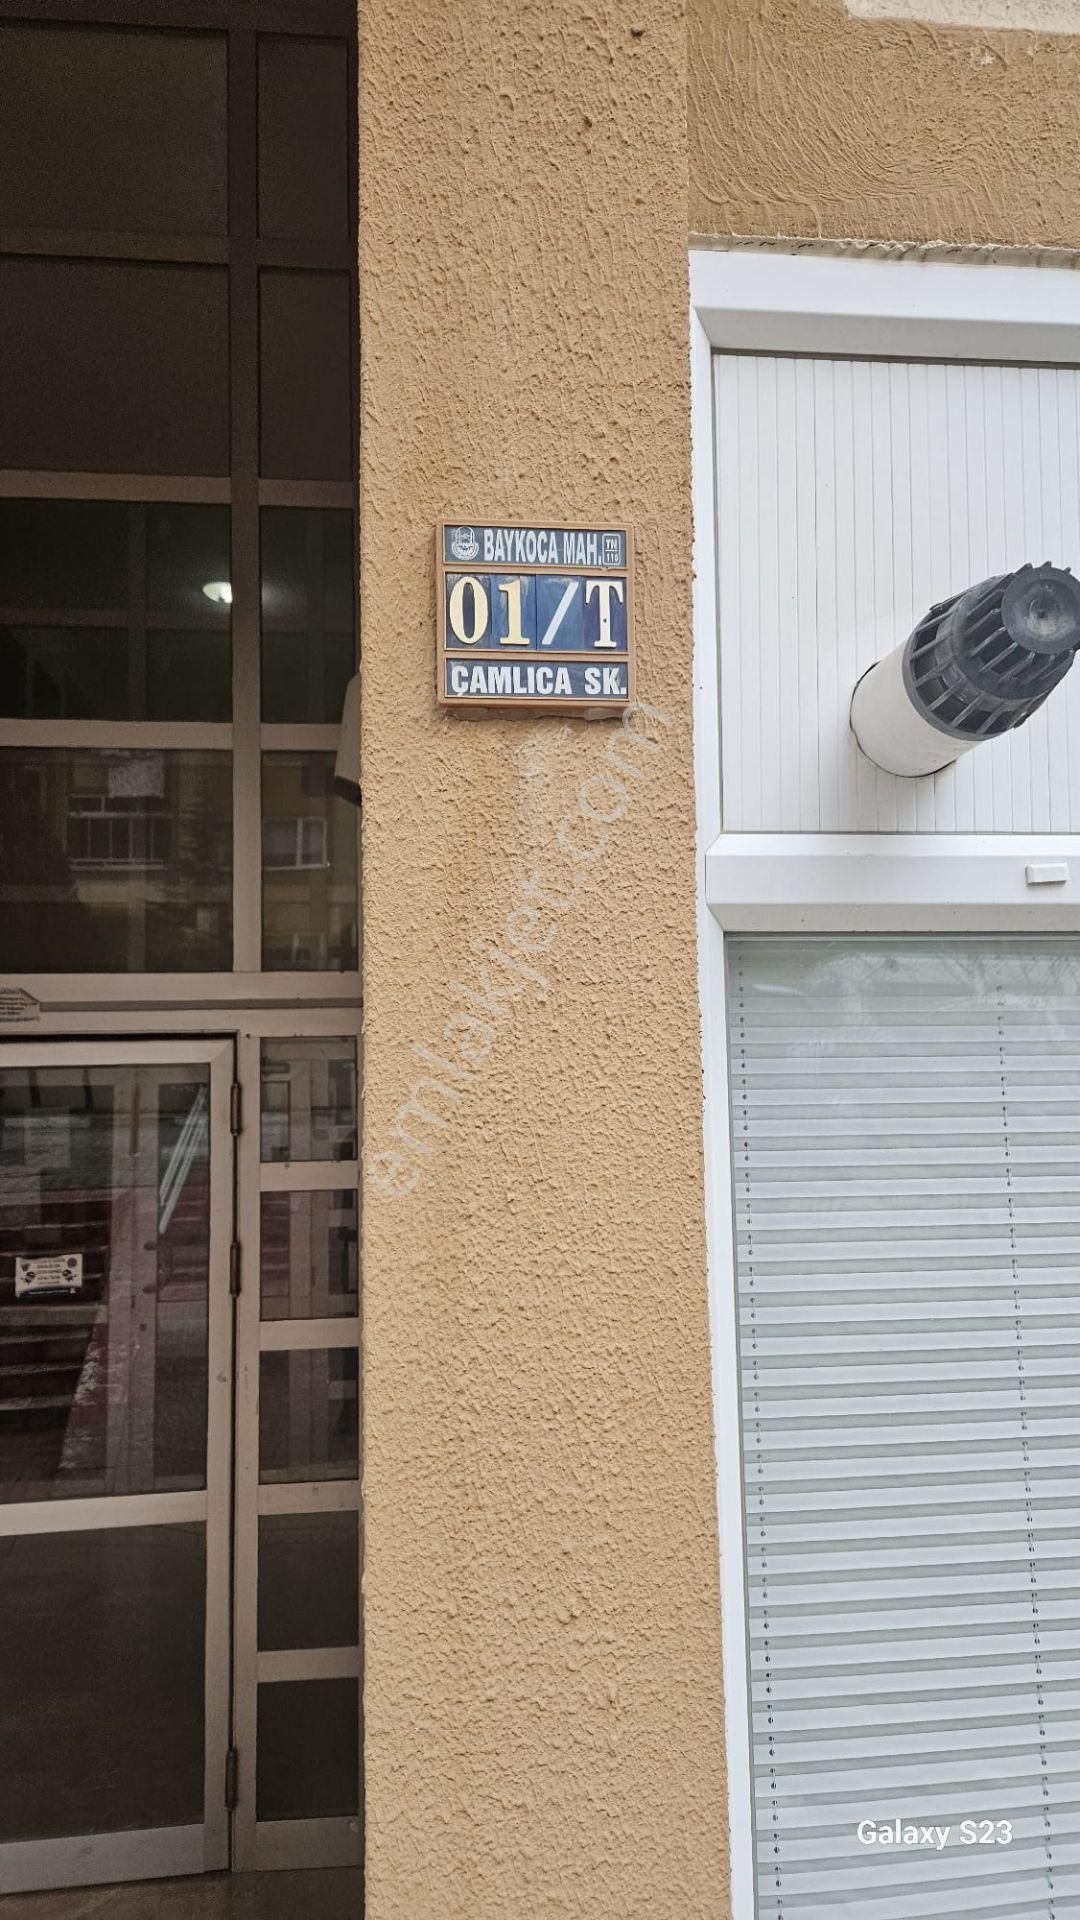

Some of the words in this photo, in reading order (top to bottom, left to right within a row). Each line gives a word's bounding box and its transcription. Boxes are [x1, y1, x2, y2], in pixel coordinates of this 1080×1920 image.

[483, 529, 558, 564] BAYKOCA
[563, 532, 602, 566] MAH.
[449, 576, 623, 648] 01/T
[584, 667, 627, 695] SK.
